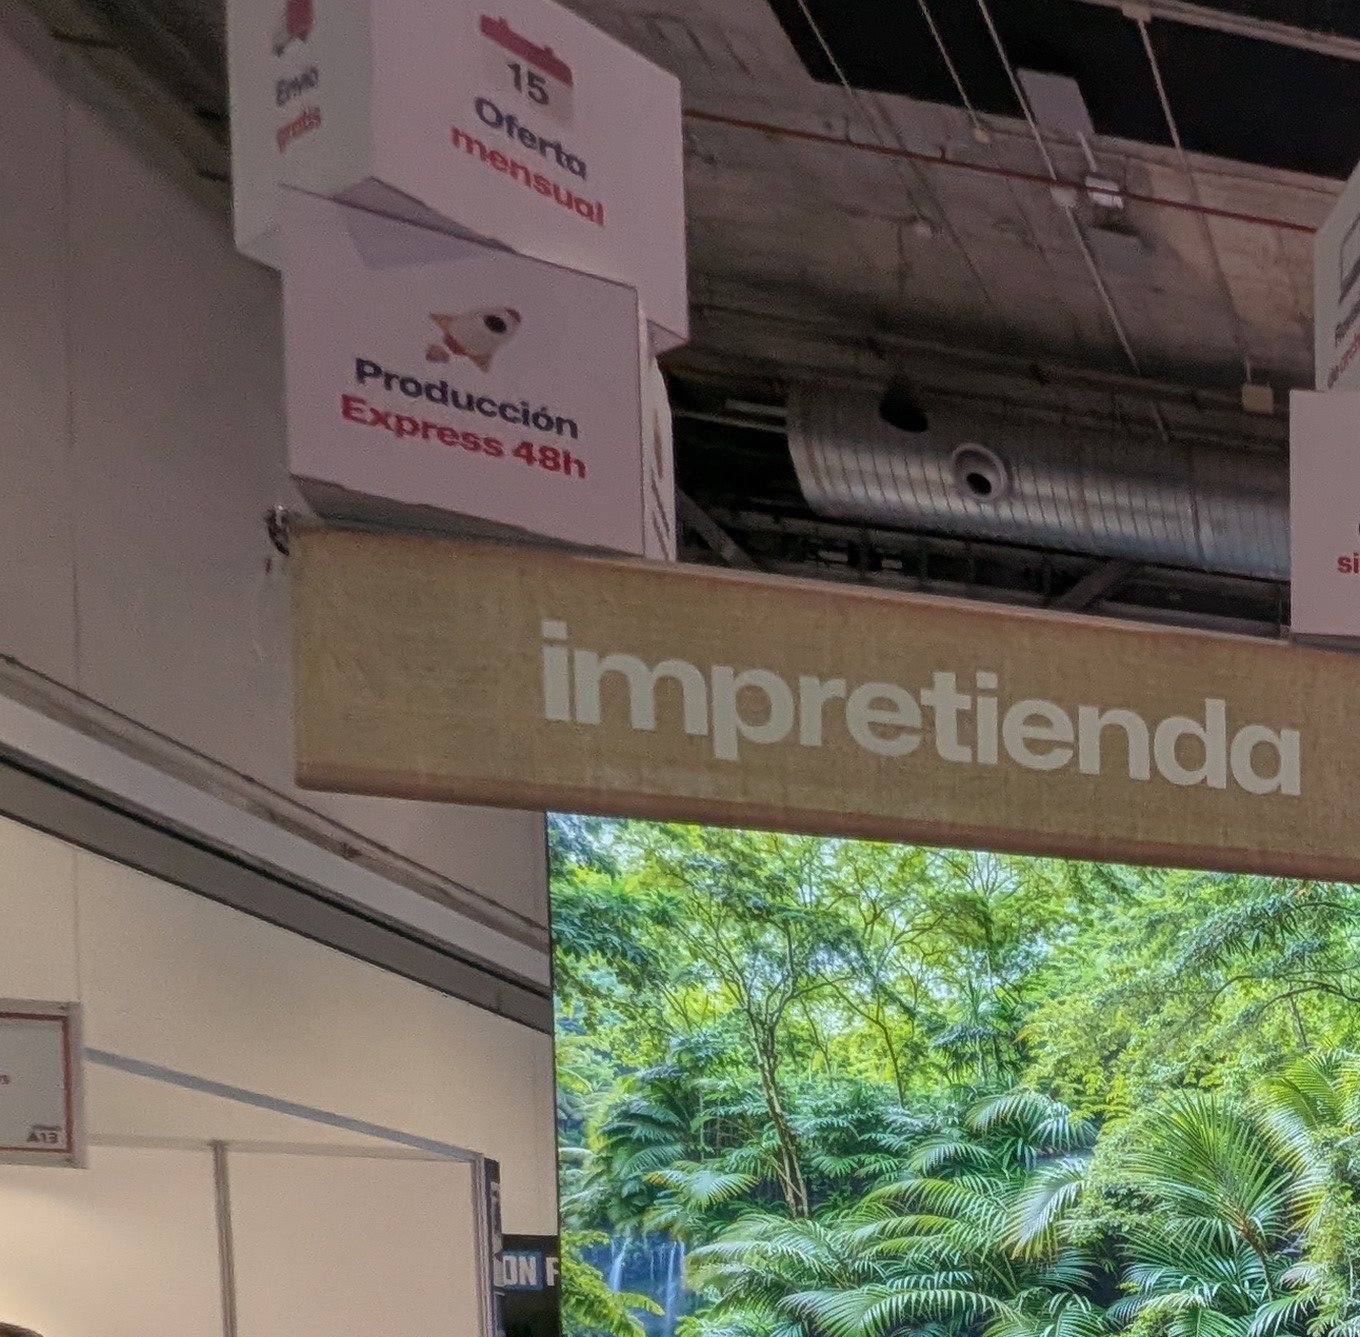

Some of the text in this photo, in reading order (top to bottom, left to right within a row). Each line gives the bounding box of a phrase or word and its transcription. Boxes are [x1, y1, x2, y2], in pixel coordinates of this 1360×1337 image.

[506, 62, 549, 105] 15
[450, 126, 605, 227] mensual
[474, 97, 587, 181] Oferta
[341, 394, 586, 479] Express 48h
[355, 356, 578, 439] Producción
[542, 620, 1302, 797] impretienda
